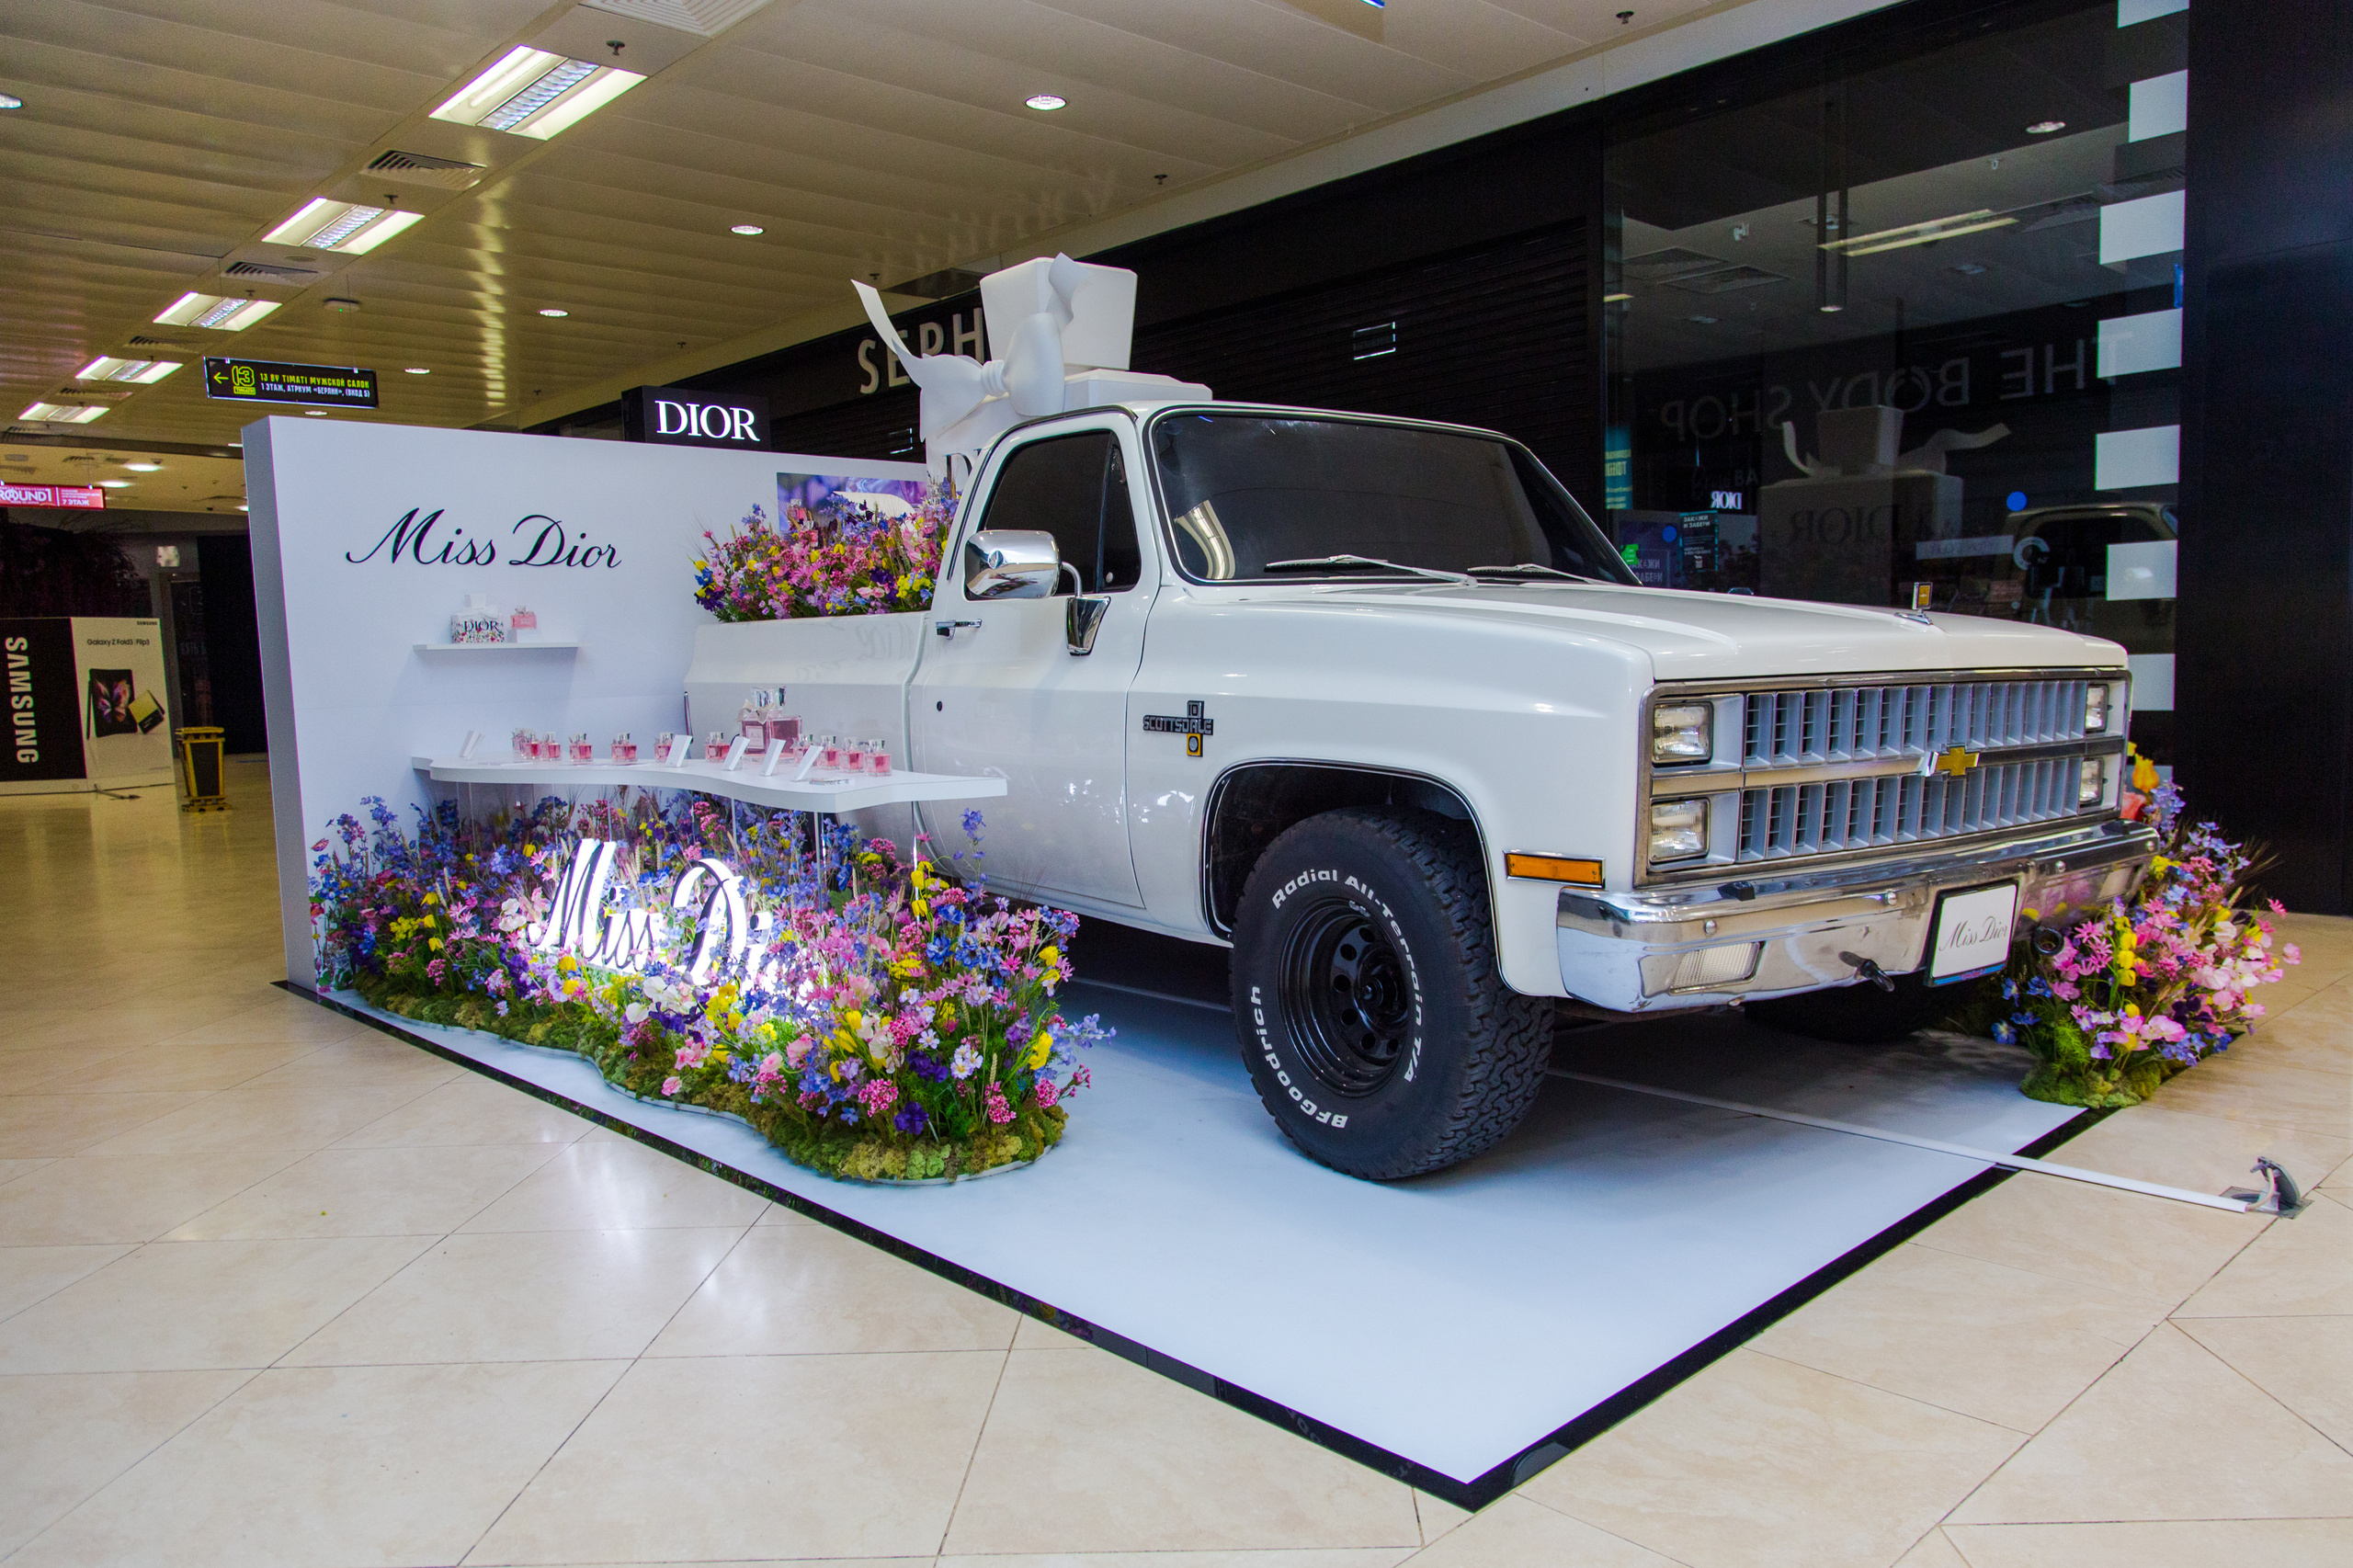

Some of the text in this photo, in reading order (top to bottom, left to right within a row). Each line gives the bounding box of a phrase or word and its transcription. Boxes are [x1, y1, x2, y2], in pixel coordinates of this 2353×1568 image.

[260, 373, 268, 381] 13
[270, 374, 279, 382] BY
[310, 377, 345, 387] МУЖСКОЙ
[347, 379, 369, 389] САЛОН
[260, 382, 265, 391] 1
[287, 384, 313, 393] АТРИУМ
[654, 400, 760, 441] DIOR
[345, 507, 622, 568] Miss Dior
[463, 619, 501, 632] DIOR
[86, 638, 110, 646] Galaxy
[5, 637, 40, 763] SAMSUNG
[1188, 704, 1199, 716] 10
[1142, 715, 1212, 734] SCOTTSDALE
[1938, 916, 2008, 951] Miss Dior
[1272, 869, 1423, 1083] Radial All-Terrain T/A
[1251, 986, 1348, 1129] BFGoodrich
